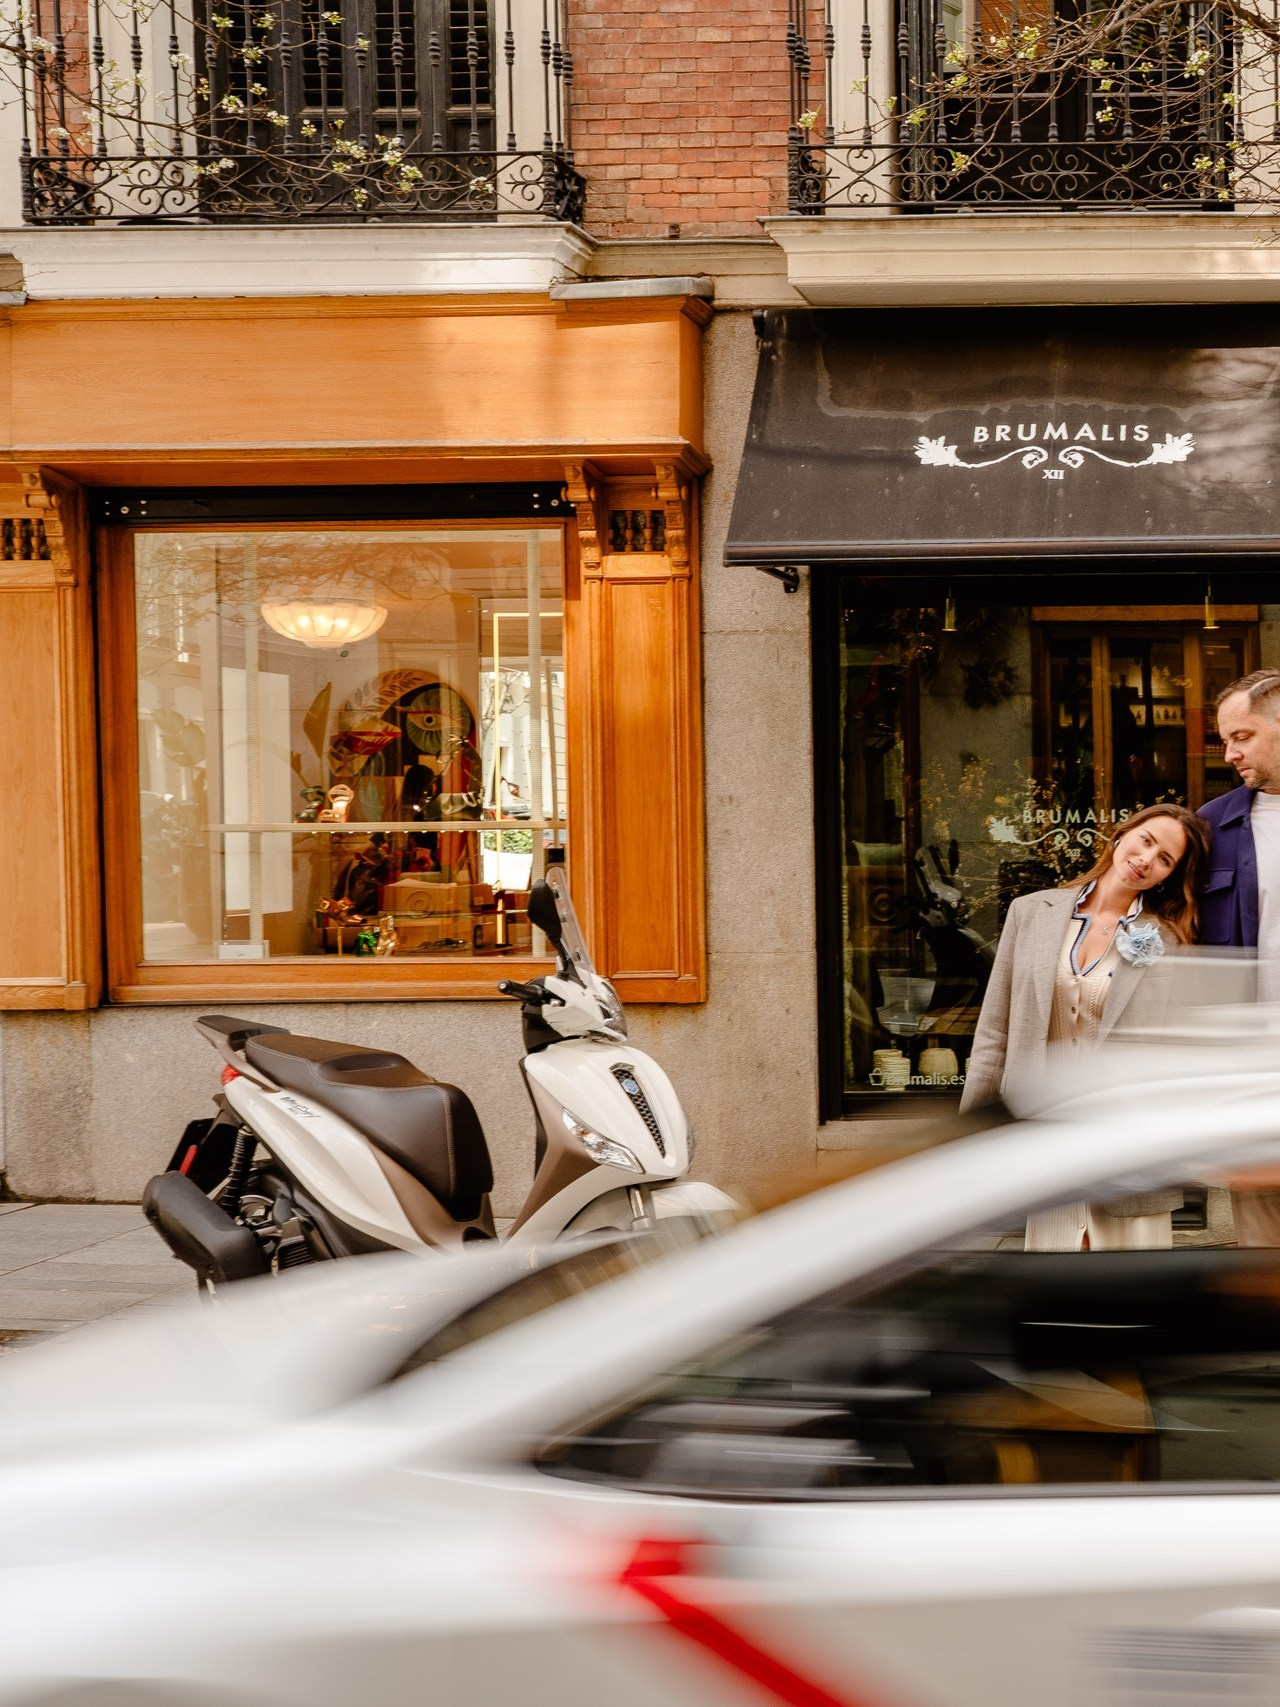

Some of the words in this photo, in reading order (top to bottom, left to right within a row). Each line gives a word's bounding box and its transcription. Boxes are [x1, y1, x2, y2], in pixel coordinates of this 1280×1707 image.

[972, 423, 1150, 443] BRUMALIS
[1042, 469, 1065, 480] XII
[1022, 808, 1130, 824] BRUMALIS
